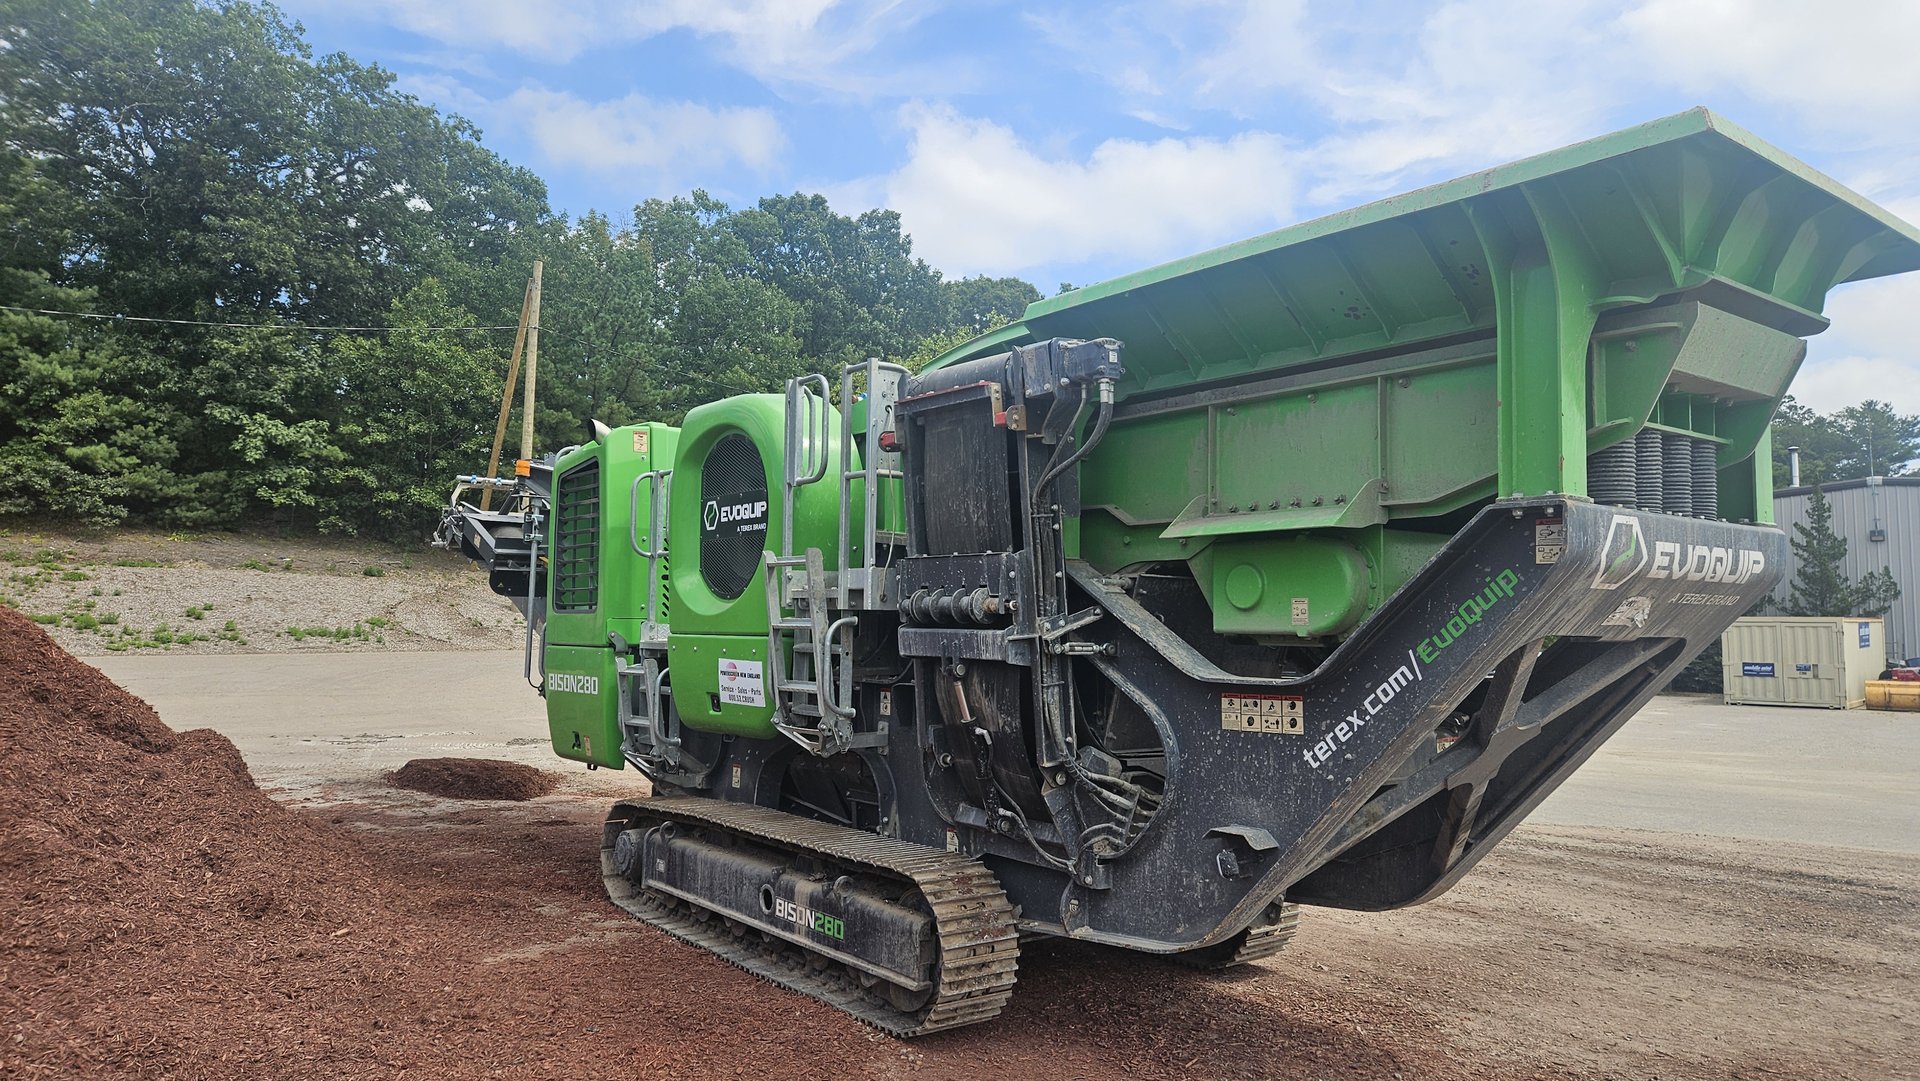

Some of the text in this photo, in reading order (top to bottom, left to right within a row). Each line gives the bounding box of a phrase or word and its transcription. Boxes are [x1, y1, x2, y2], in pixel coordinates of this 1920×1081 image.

[721, 501, 767, 522] EVOQUIP
[1647, 541, 1765, 585] EVOQUIP
[1668, 593, 1740, 606] A TEREX BRAND
[549, 673, 598, 695] BISON280
[775, 898, 844, 940] BISON280
